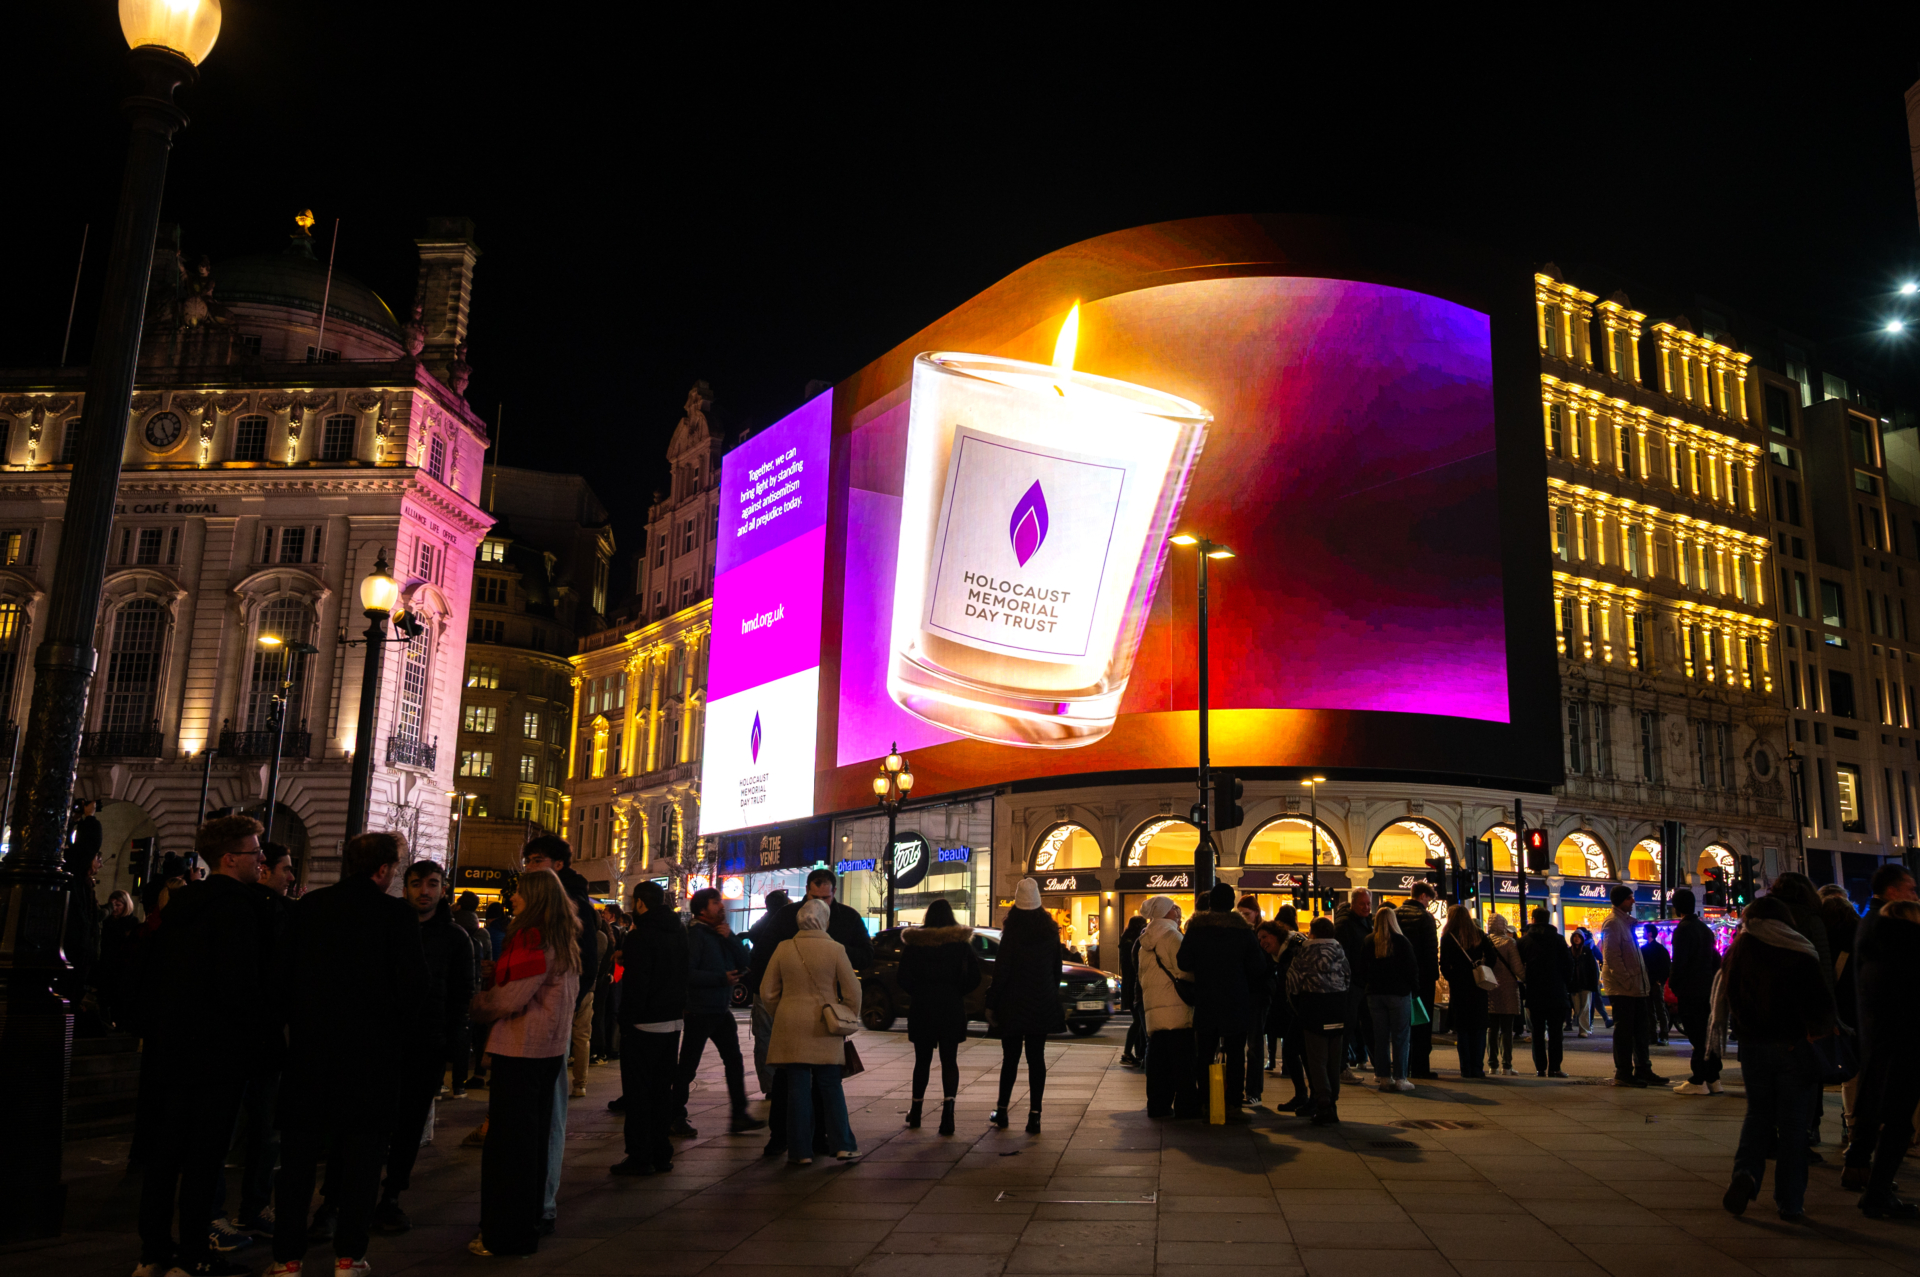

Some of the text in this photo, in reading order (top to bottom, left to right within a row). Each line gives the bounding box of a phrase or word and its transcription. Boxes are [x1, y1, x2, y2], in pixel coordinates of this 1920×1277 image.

[748, 447, 797, 482] Together, we can
[740, 460, 804, 503] bring light by standing
[133, 501, 169, 514] CAFÉ
[174, 504, 219, 514] ROYAL
[741, 479, 800, 519] against antisemitism
[404, 505, 457, 545] ALLIANCE LIFE OFFICE
[736, 495, 803, 537] and all prejudice today.
[963, 570, 1071, 604] HOLOCAUST
[967, 588, 1059, 618] MEMORIAL
[741, 602, 785, 635] hmd.org.uk
[964, 603, 1058, 633] DAY TRUST
[739, 772, 770, 787] HOLOCAUST
[740, 784, 767, 797] MEMORIAL
[740, 794, 767, 808] DAY TRUST
[769, 835, 781, 850] THE
[760, 850, 780, 866] VENUE
[937, 845, 970, 863] beauty
[464, 869, 502, 881] carpo
[837, 858, 876, 876] pharmacy
[1146, 874, 1180, 888] Lindt
[1579, 884, 1600, 898] Lindt
